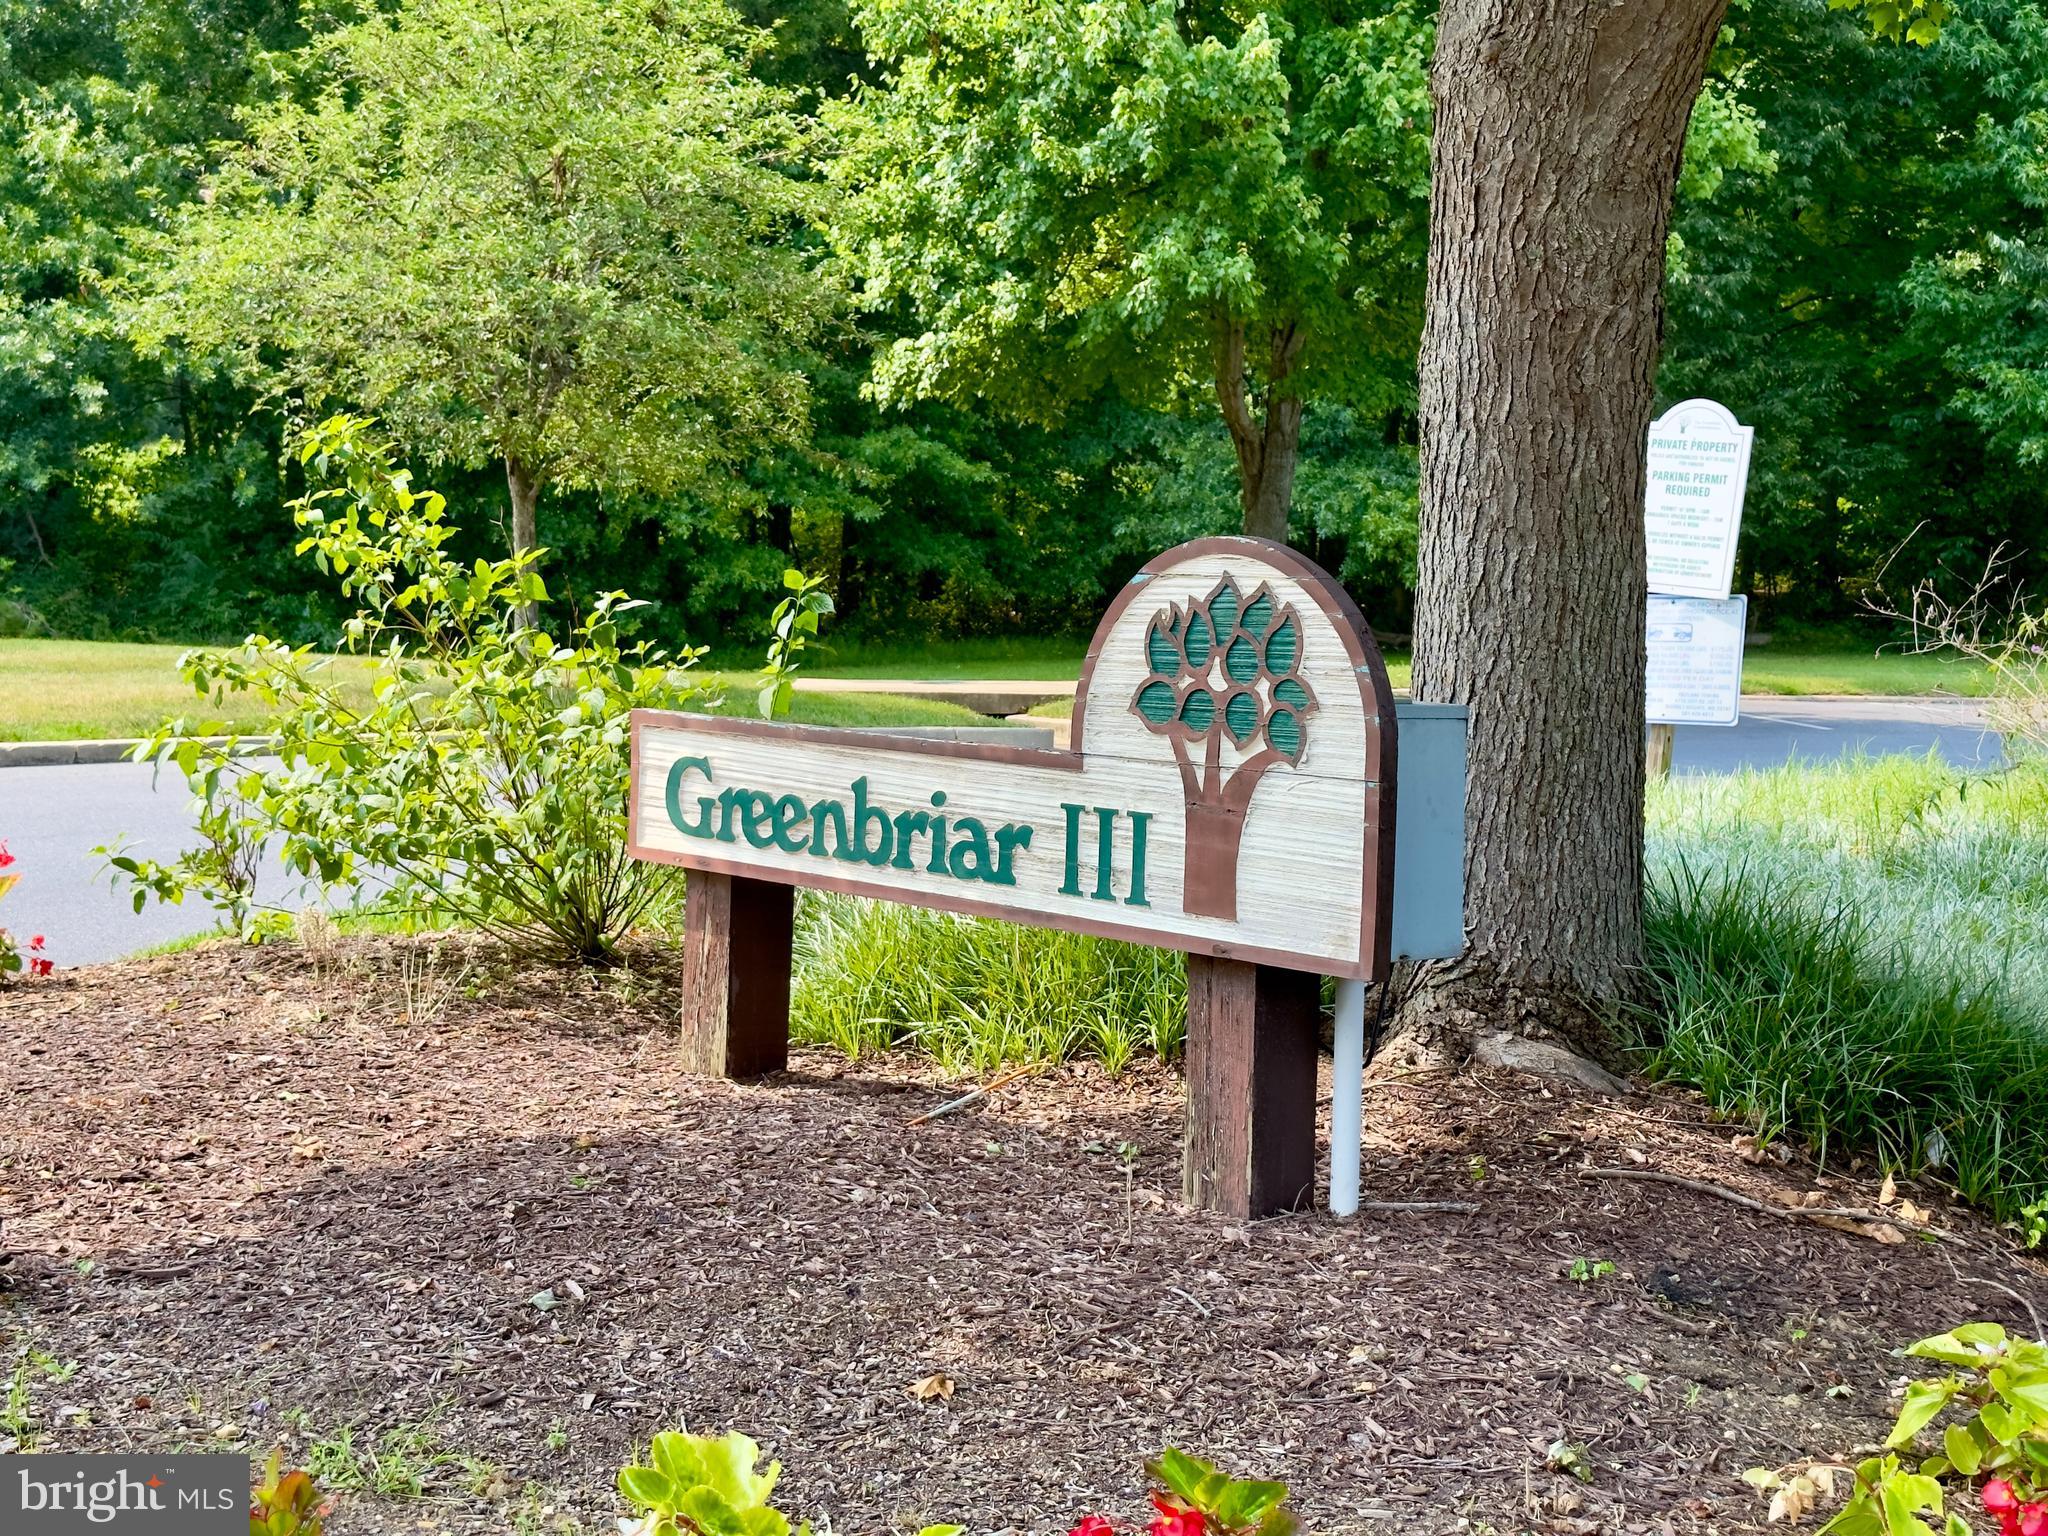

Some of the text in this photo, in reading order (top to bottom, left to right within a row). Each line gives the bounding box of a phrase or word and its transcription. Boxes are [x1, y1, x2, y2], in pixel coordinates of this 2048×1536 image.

[1651, 438, 1739, 454] PRIVATE PROPERTY
[1652, 470, 1728, 485] PARKING PERMIT
[1665, 484, 1711, 498] REQUIRED
[665, 755, 1154, 908] Greenbriar III
